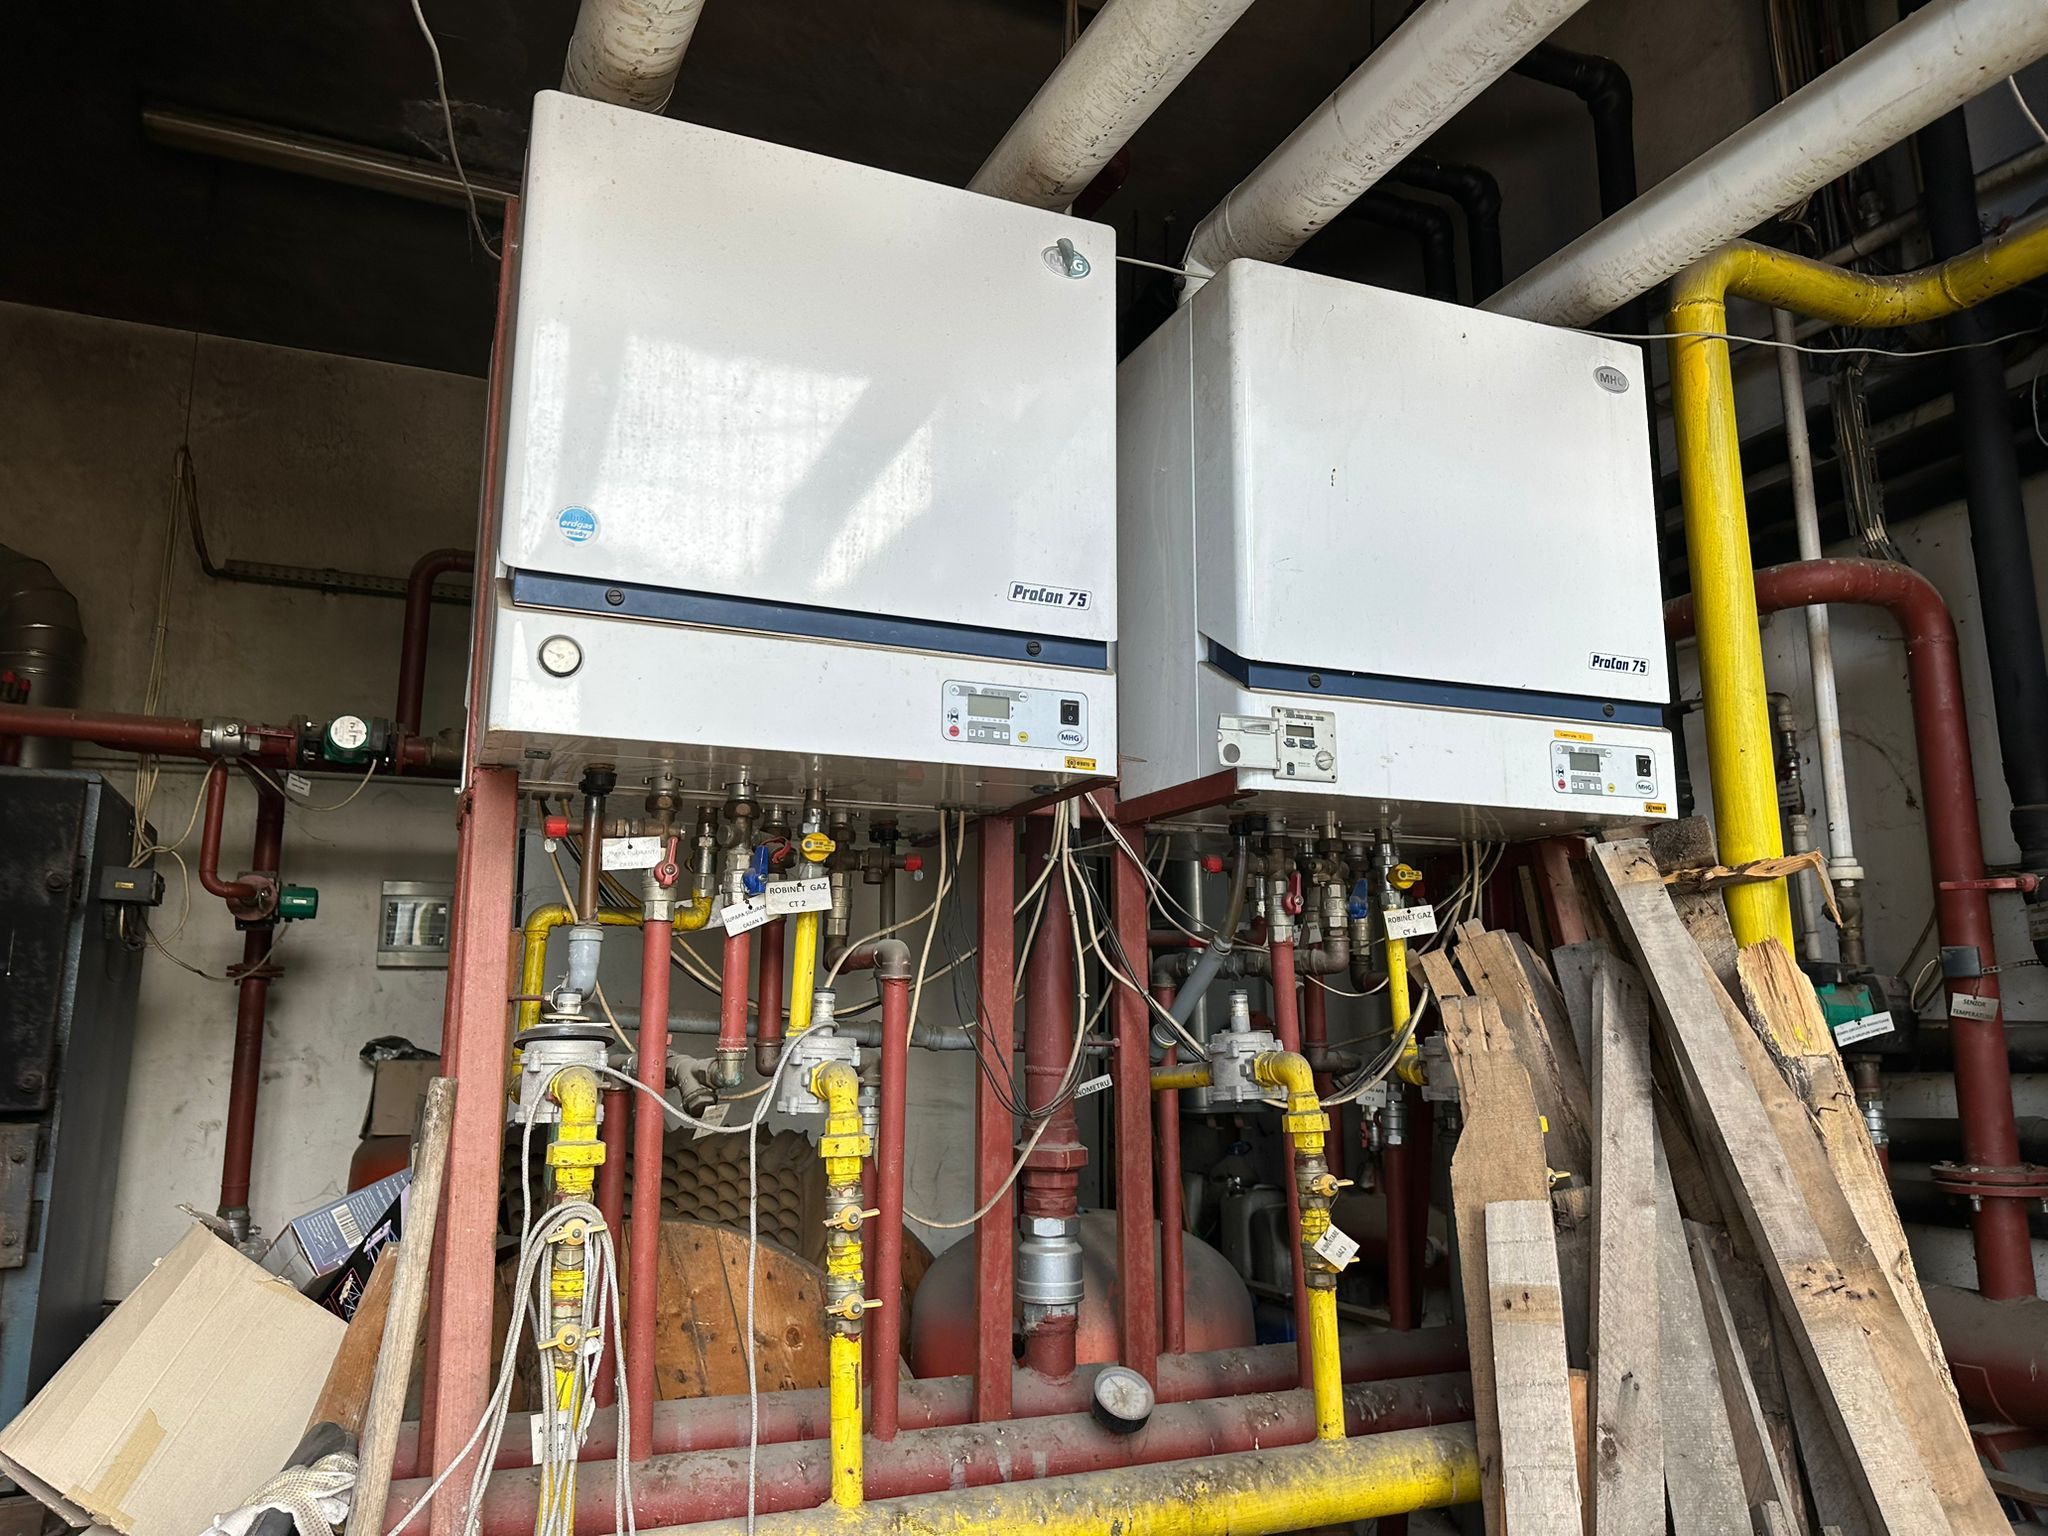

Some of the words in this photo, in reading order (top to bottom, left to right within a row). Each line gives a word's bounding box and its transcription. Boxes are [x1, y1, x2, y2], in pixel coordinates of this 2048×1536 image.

[1012, 584, 1063, 604] ProCon
[1067, 592, 1087, 607] 75
[1591, 655, 1629, 671] ProCon
[1632, 660, 1647, 673] 75
[1061, 733, 1080, 742] MHG
[769, 886, 806, 894] ROBINET
[810, 883, 827, 891] GAZ
[1387, 913, 1416, 924] ROBINET
[1416, 911, 1432, 920] GAZ
[1963, 998, 1986, 1008] SENZOR
